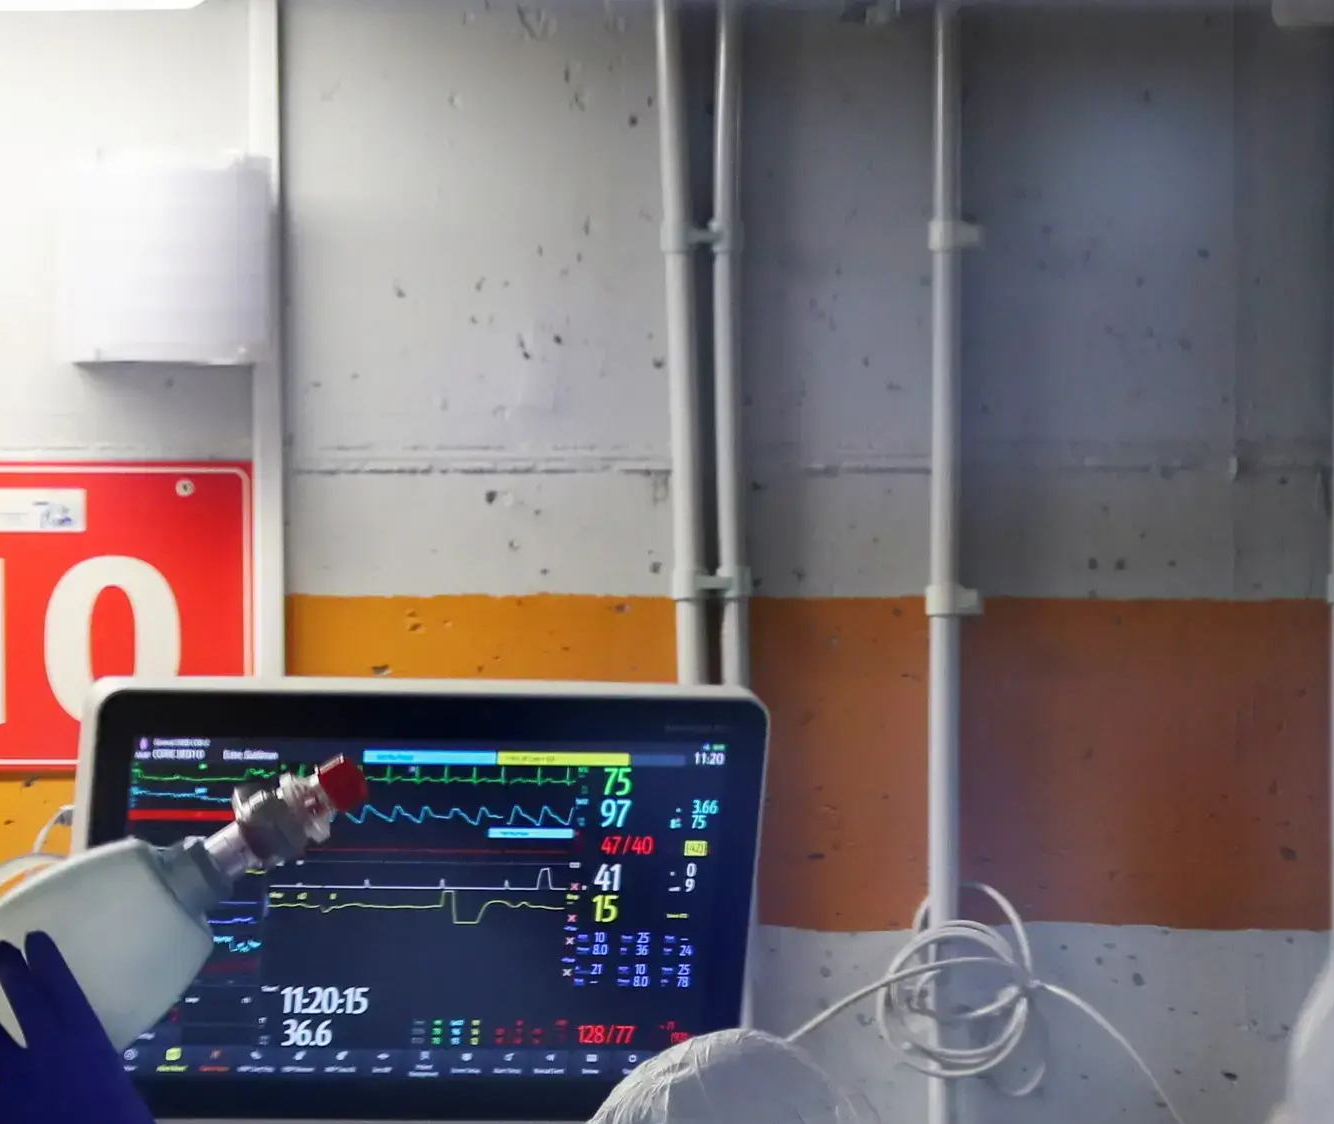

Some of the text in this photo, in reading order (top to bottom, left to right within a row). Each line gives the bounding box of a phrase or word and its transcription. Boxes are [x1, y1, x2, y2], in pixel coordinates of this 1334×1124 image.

[694, 752, 726, 766] 11:20
[603, 767, 632, 796] 75
[600, 798, 632, 828] 97
[692, 800, 719, 814] 3.66
[691, 815, 707, 829] 75
[601, 835, 655, 855] 47/40
[593, 863, 623, 892] 41
[686, 863, 697, 878] 0
[685, 878, 696, 892] 9
[592, 894, 619, 923] 15
[281, 986, 370, 1015] 11:20:15
[281, 1019, 333, 1047] 36.6
[578, 1025, 636, 1044] 128/77
